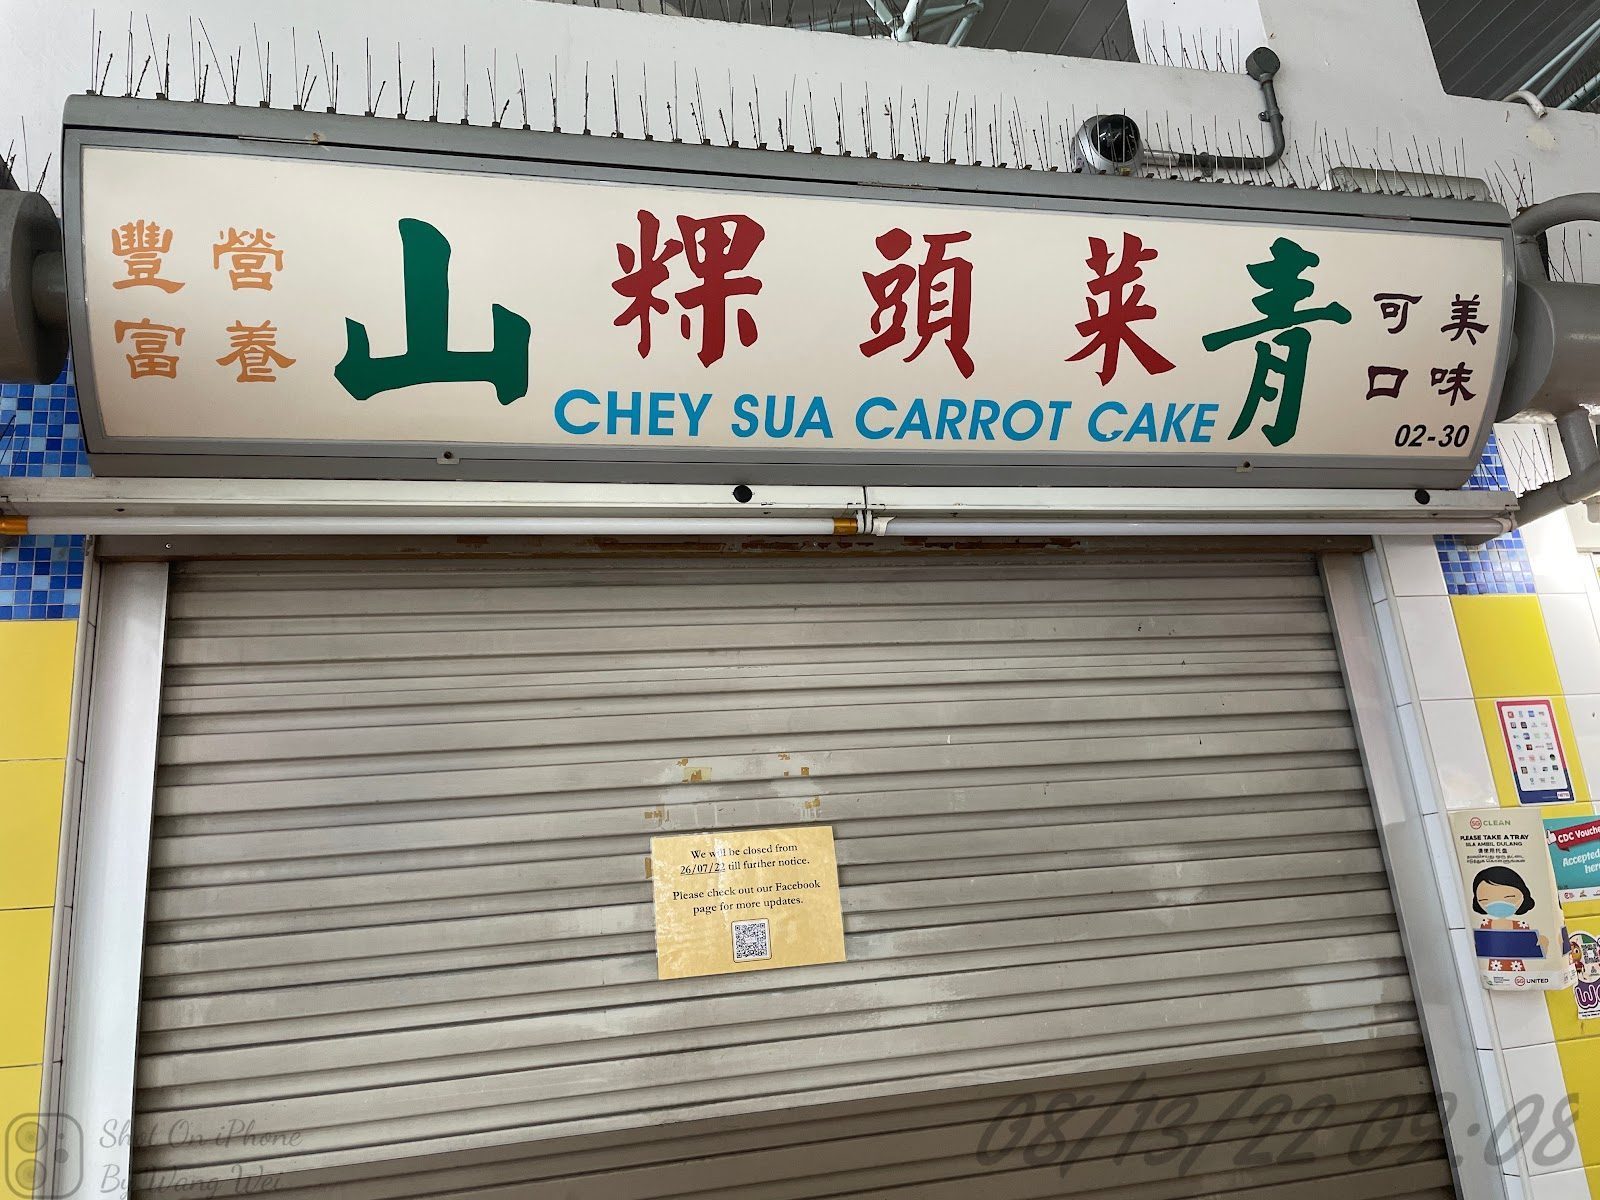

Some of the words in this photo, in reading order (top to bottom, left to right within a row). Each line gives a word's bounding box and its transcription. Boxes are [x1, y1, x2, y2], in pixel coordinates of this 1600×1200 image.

[334, 218, 531, 405] 山
[1202, 237, 1352, 447] 青
[554, 389, 712, 438] CHEY
[731, 394, 833, 439] SUA
[855, 397, 1072, 442] CARROT
[1087, 401, 1219, 443] CAKE
[1394, 424, 1469, 448] 02-30
[1557, 832, 1574, 843] CDC
[690, 850, 706, 859] We
[709, 848, 726, 858] will
[728, 847, 741, 857] be
[743, 844, 773, 855] closed
[775, 843, 798, 853] from
[1562, 848, 1600, 867] Accepted
[680, 862, 726, 875] 26/07/22
[728, 861, 741, 871] till
[743, 857, 776, 869] further
[778, 857, 810, 867] notice.
[672, 889, 705, 900] Please
[707, 886, 736, 898] check
[738, 885, 754, 894] out
[756, 884, 773, 893] our
[775, 880, 821, 891] Facebook
[692, 905, 717, 917] page
[720, 901, 734, 911] for
[736, 900, 761, 909] more
[763, 896, 804, 910] updates.
